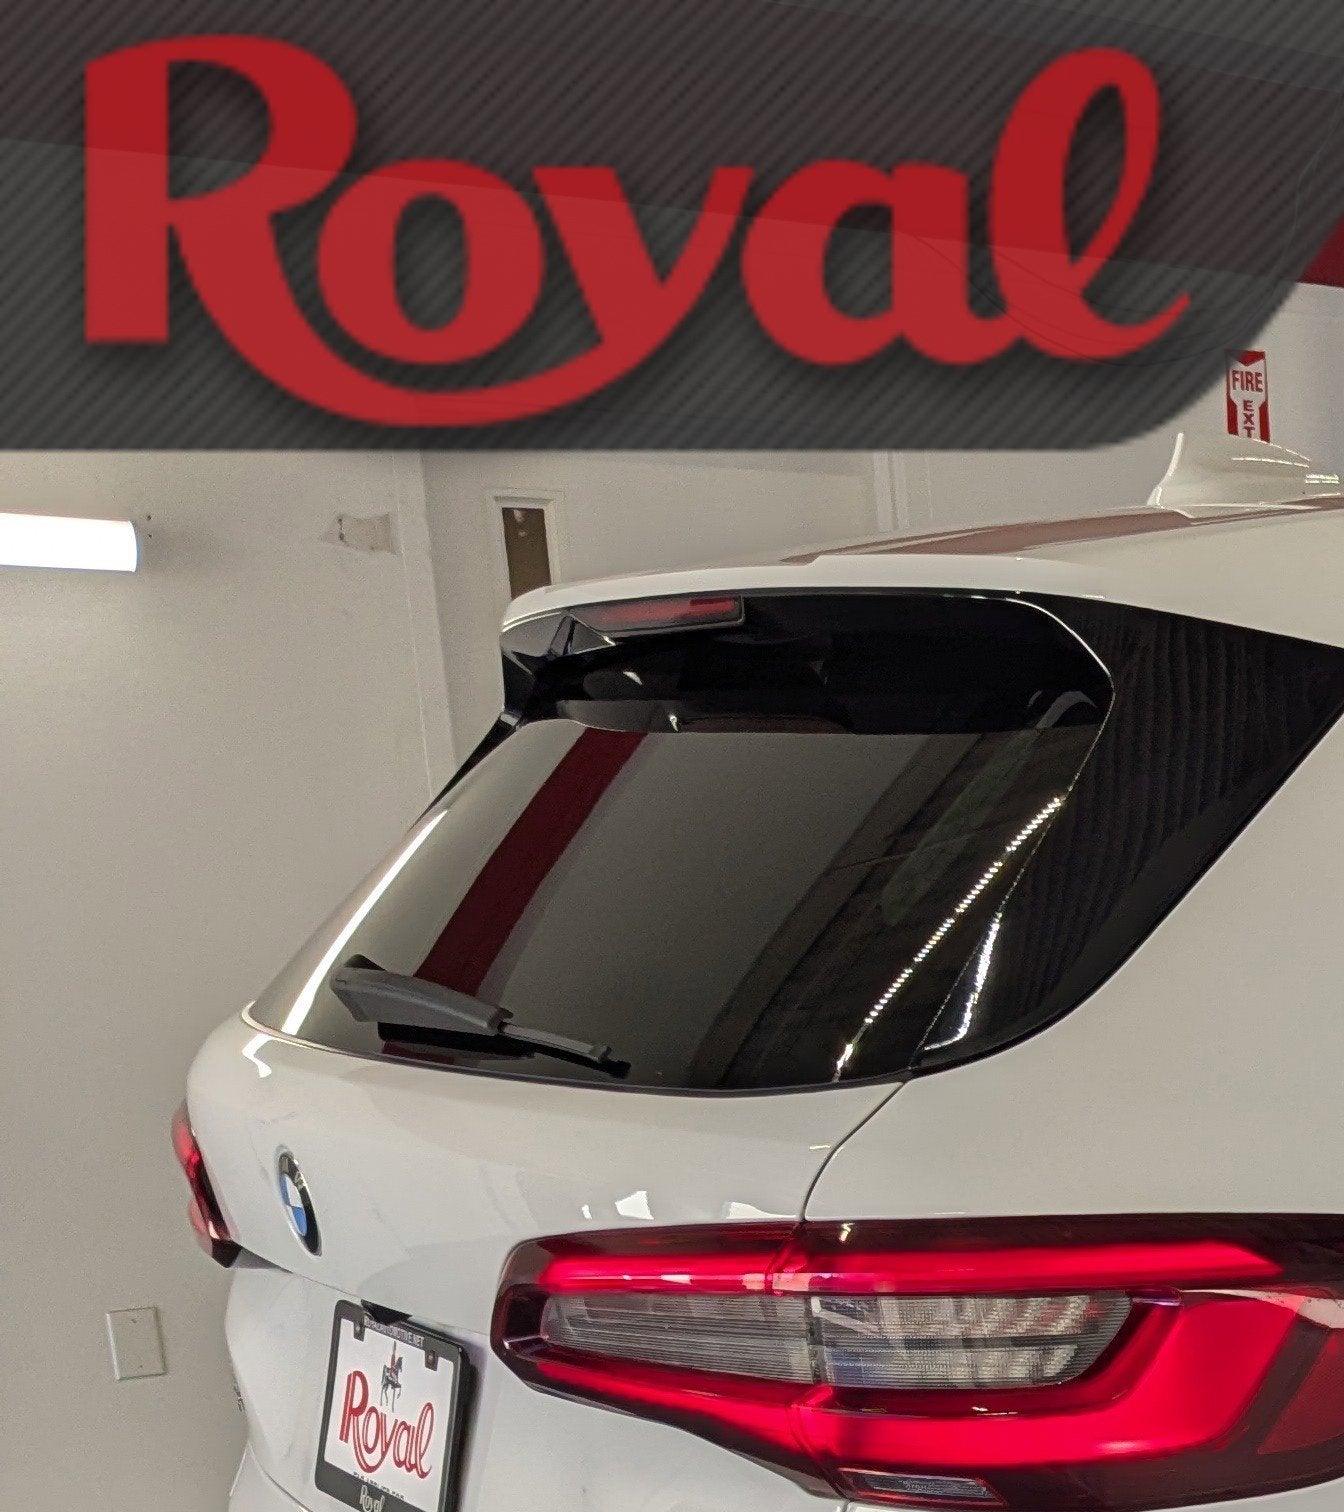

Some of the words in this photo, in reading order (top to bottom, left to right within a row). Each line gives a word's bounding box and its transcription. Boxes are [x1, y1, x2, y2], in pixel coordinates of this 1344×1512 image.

[1231, 369, 1263, 392] FIRE
[1242, 399, 1256, 438] EXT
[339, 1370, 434, 1479] Royal
